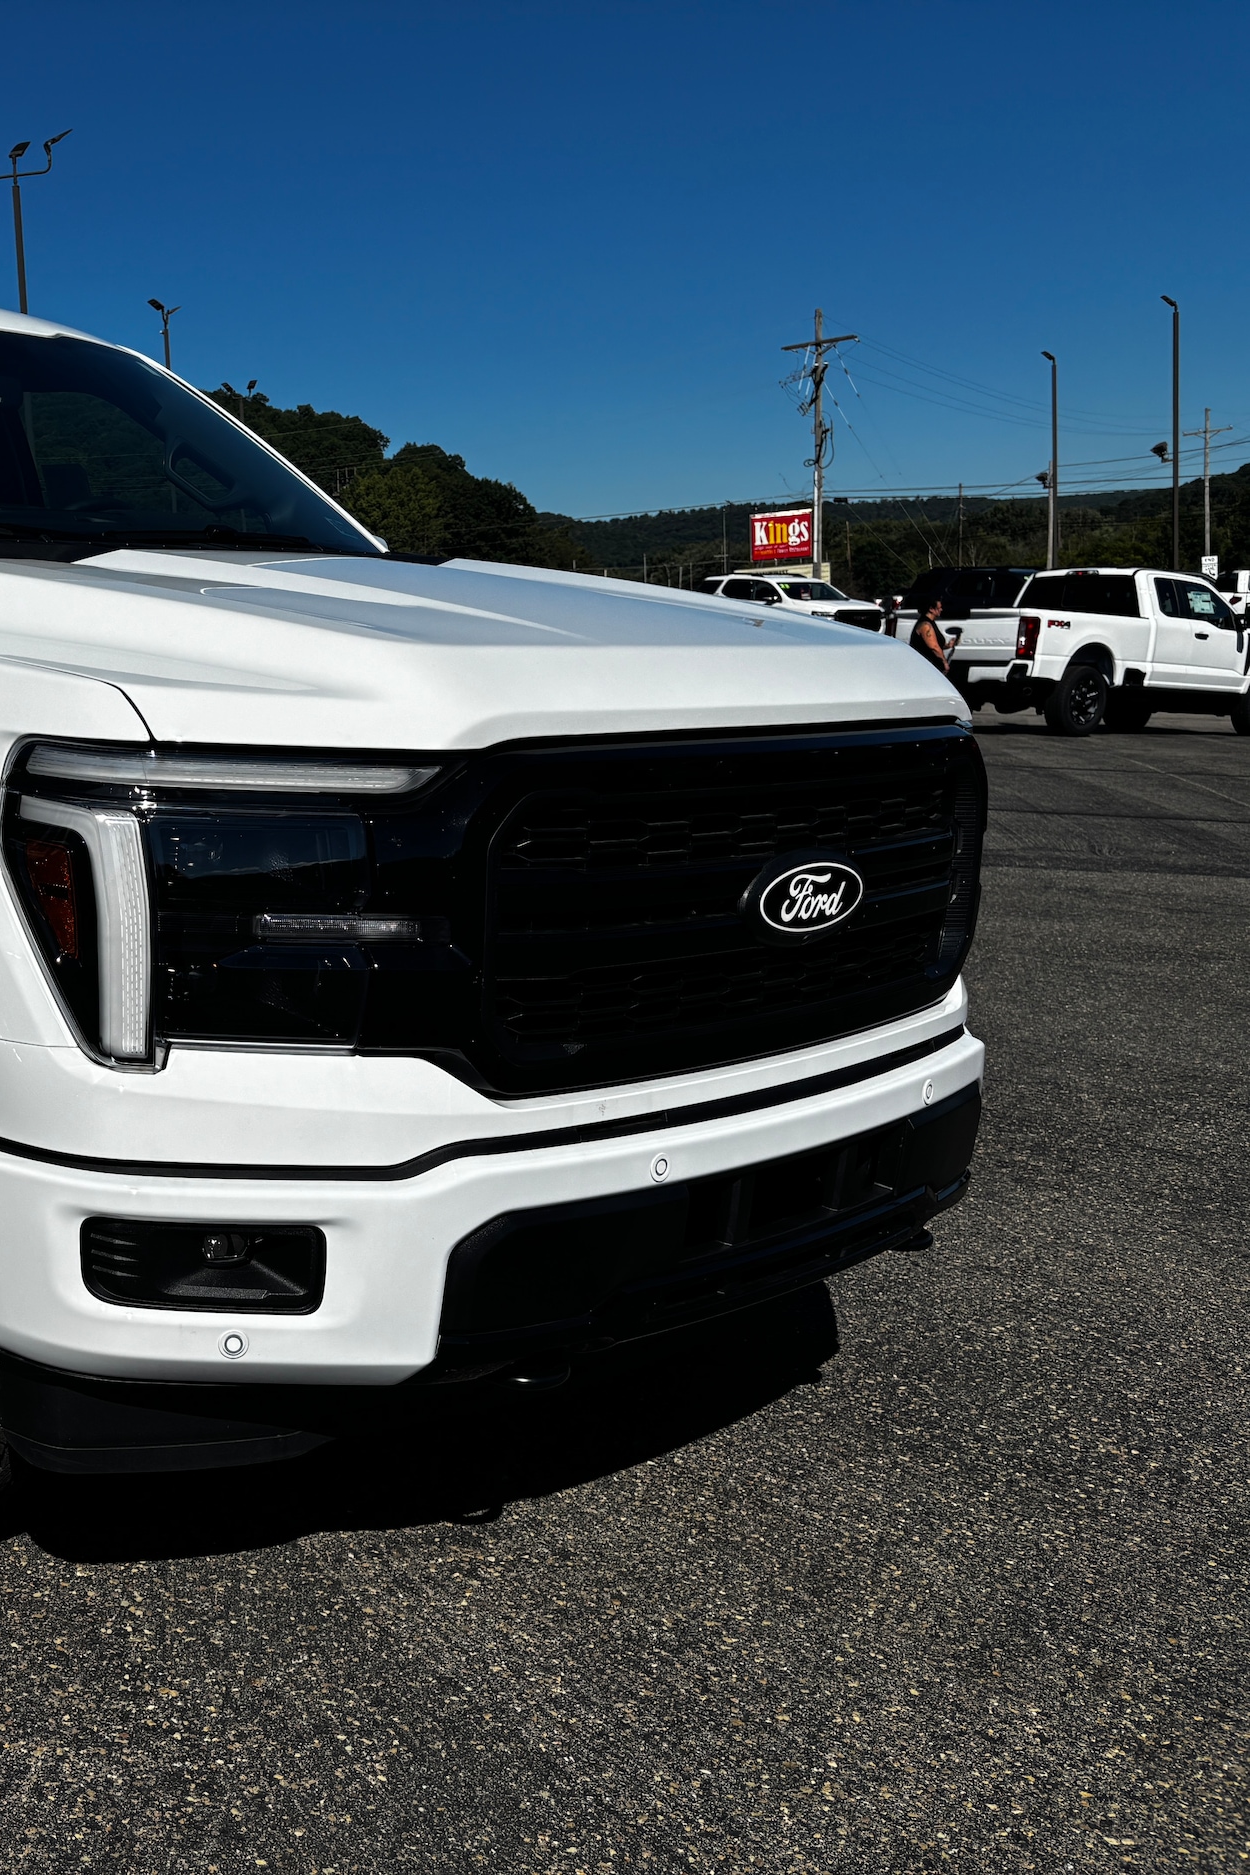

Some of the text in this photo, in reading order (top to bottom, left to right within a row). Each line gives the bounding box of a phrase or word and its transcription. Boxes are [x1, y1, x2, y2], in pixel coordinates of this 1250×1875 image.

[753, 518, 809, 546] Kings
[1048, 620, 1070, 629] FX4
[780, 873, 846, 922] Ford
